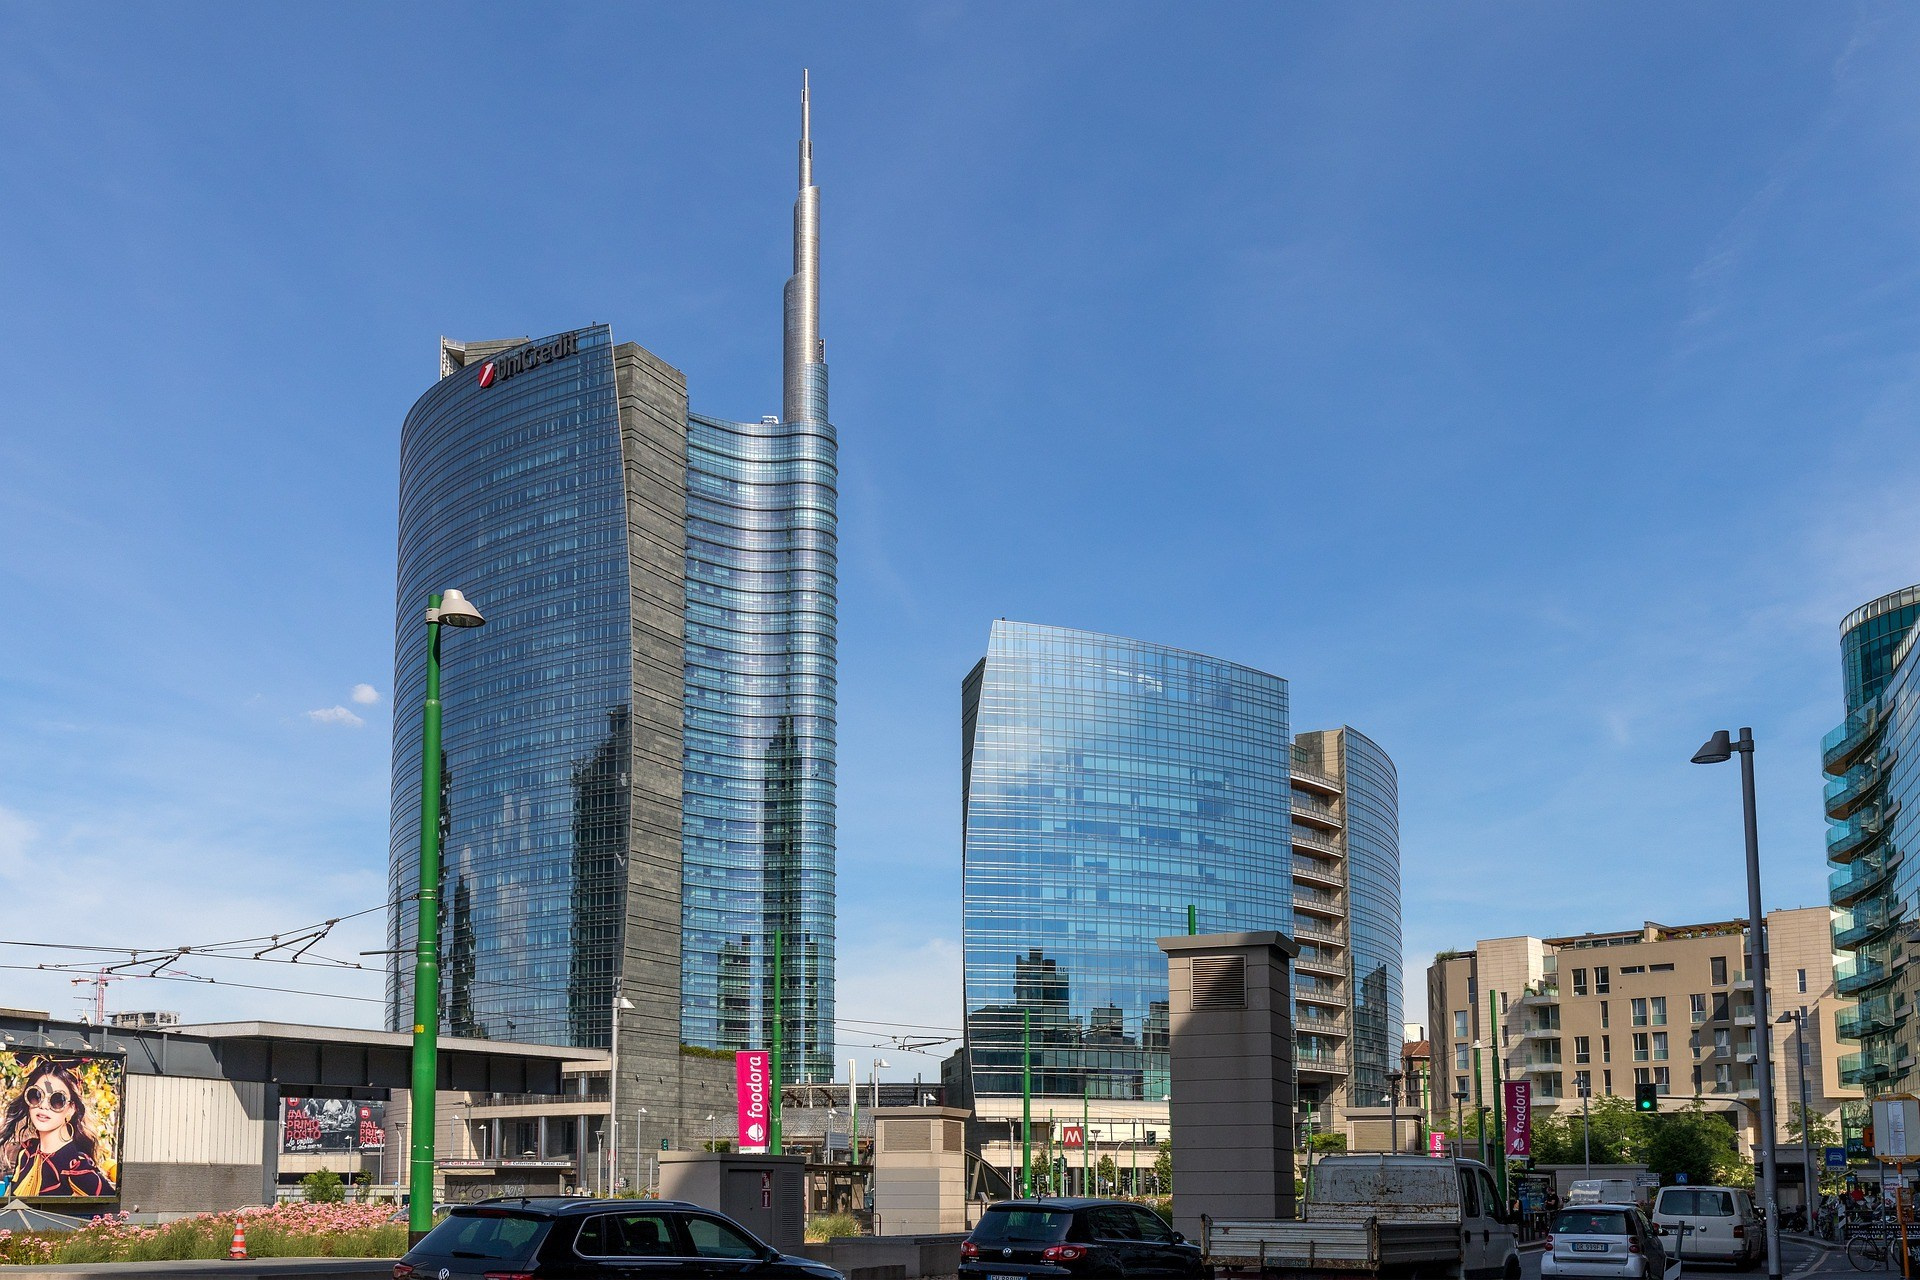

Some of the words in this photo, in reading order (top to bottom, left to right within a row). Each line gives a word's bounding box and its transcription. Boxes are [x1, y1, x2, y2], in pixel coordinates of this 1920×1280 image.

[495, 331, 578, 381] UniCredit
[746, 1055, 763, 1118] foodora
[287, 1109, 308, 1120] #AL
[1513, 1085, 1526, 1133] foodora
[286, 1120, 320, 1130] PRIMO
[286, 1130, 321, 1140] POSTO
[1065, 1130, 1082, 1143] M
